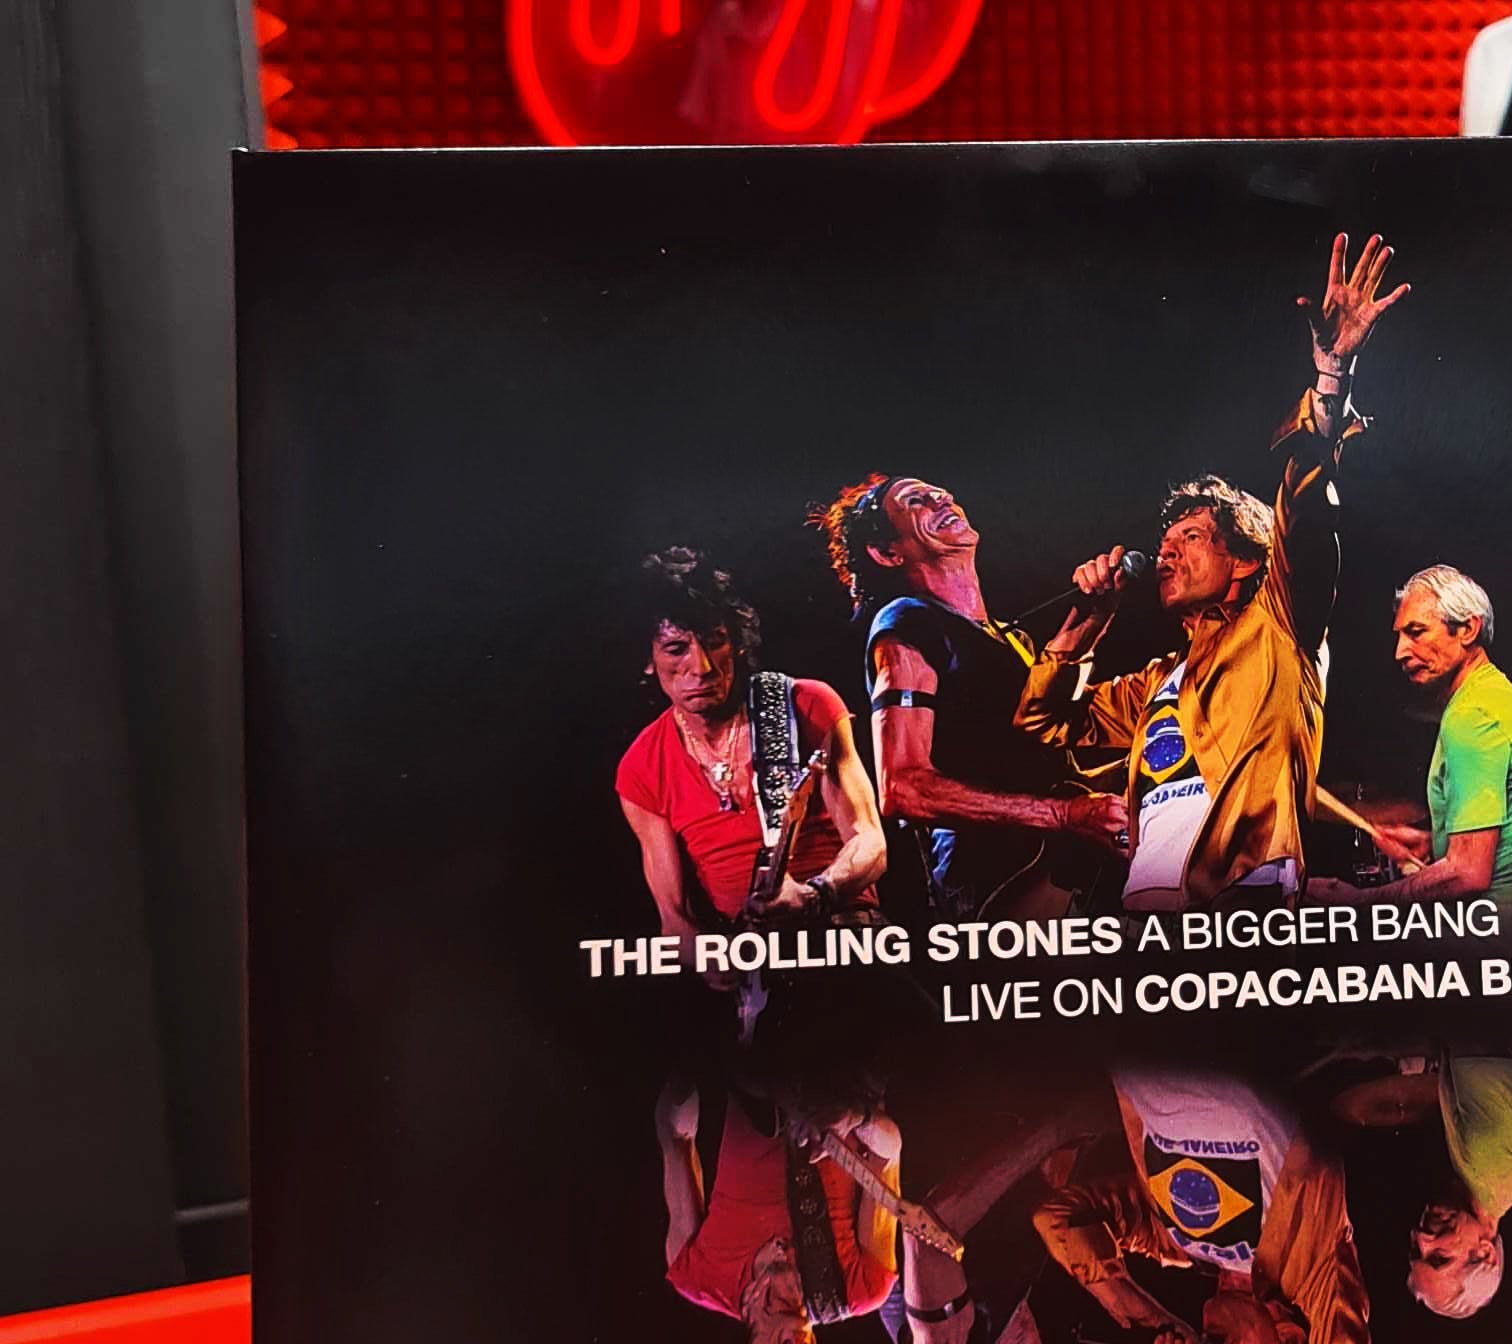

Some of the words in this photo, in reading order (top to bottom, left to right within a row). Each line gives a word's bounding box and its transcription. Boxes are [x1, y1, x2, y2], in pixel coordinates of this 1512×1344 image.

[580, 936, 681, 977] THE
[696, 924, 911, 972] ROLLING
[927, 916, 1122, 962] STONES
[1138, 915, 1170, 951] A
[1182, 905, 1359, 950] BIGGER
[1371, 899, 1500, 941] BANG
[942, 981, 1041, 1023] LIVE
[1052, 977, 1123, 1017] ON
[1135, 961, 1470, 1013] COPACABANA
